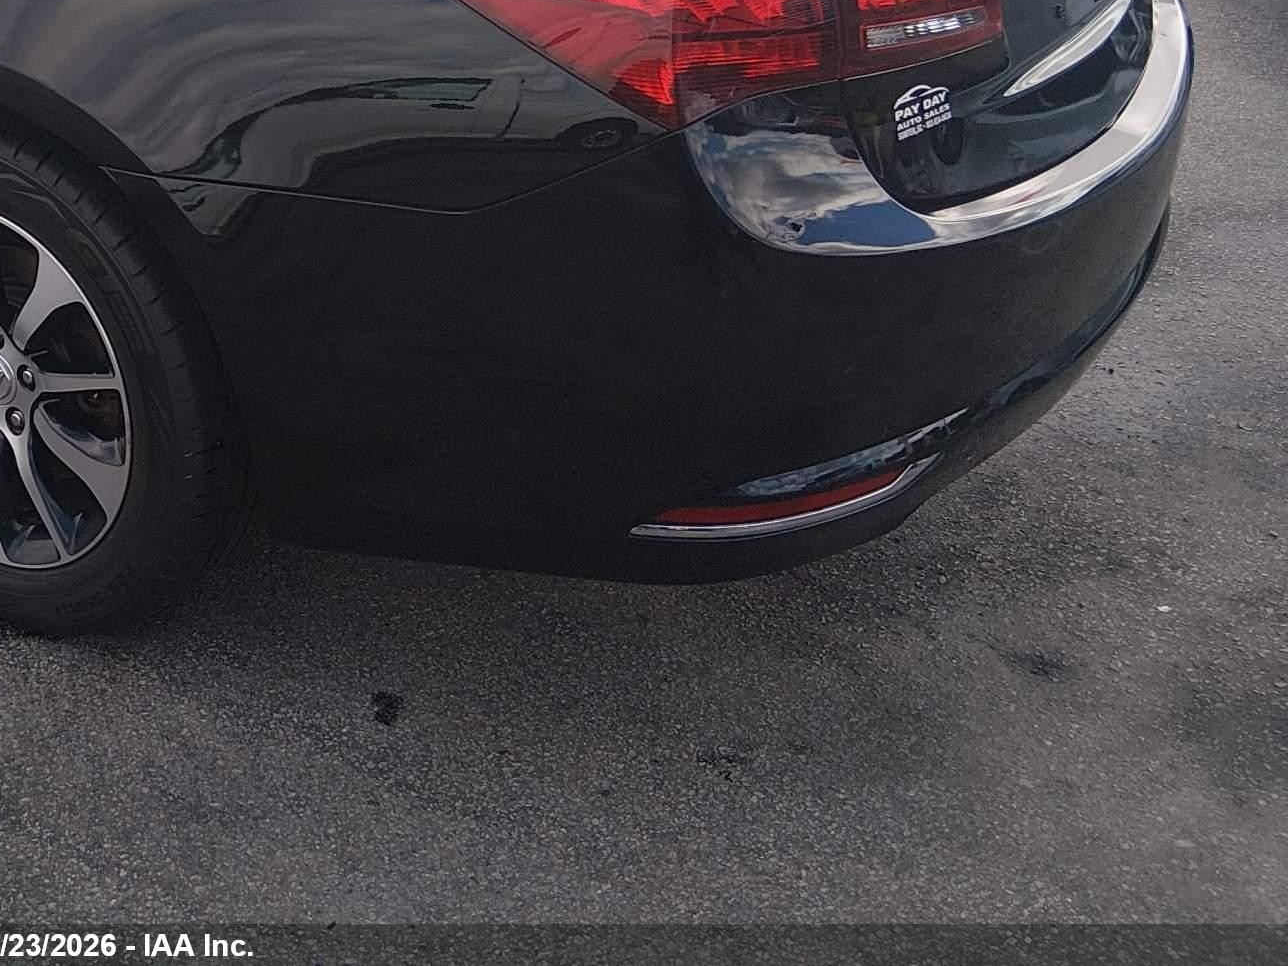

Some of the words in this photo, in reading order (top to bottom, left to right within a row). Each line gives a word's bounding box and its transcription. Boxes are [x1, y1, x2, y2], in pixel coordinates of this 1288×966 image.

[895, 103, 920, 121] PAY
[923, 91, 946, 110] DAY
[897, 116, 922, 131] AUTO
[924, 103, 950, 120] SALES
